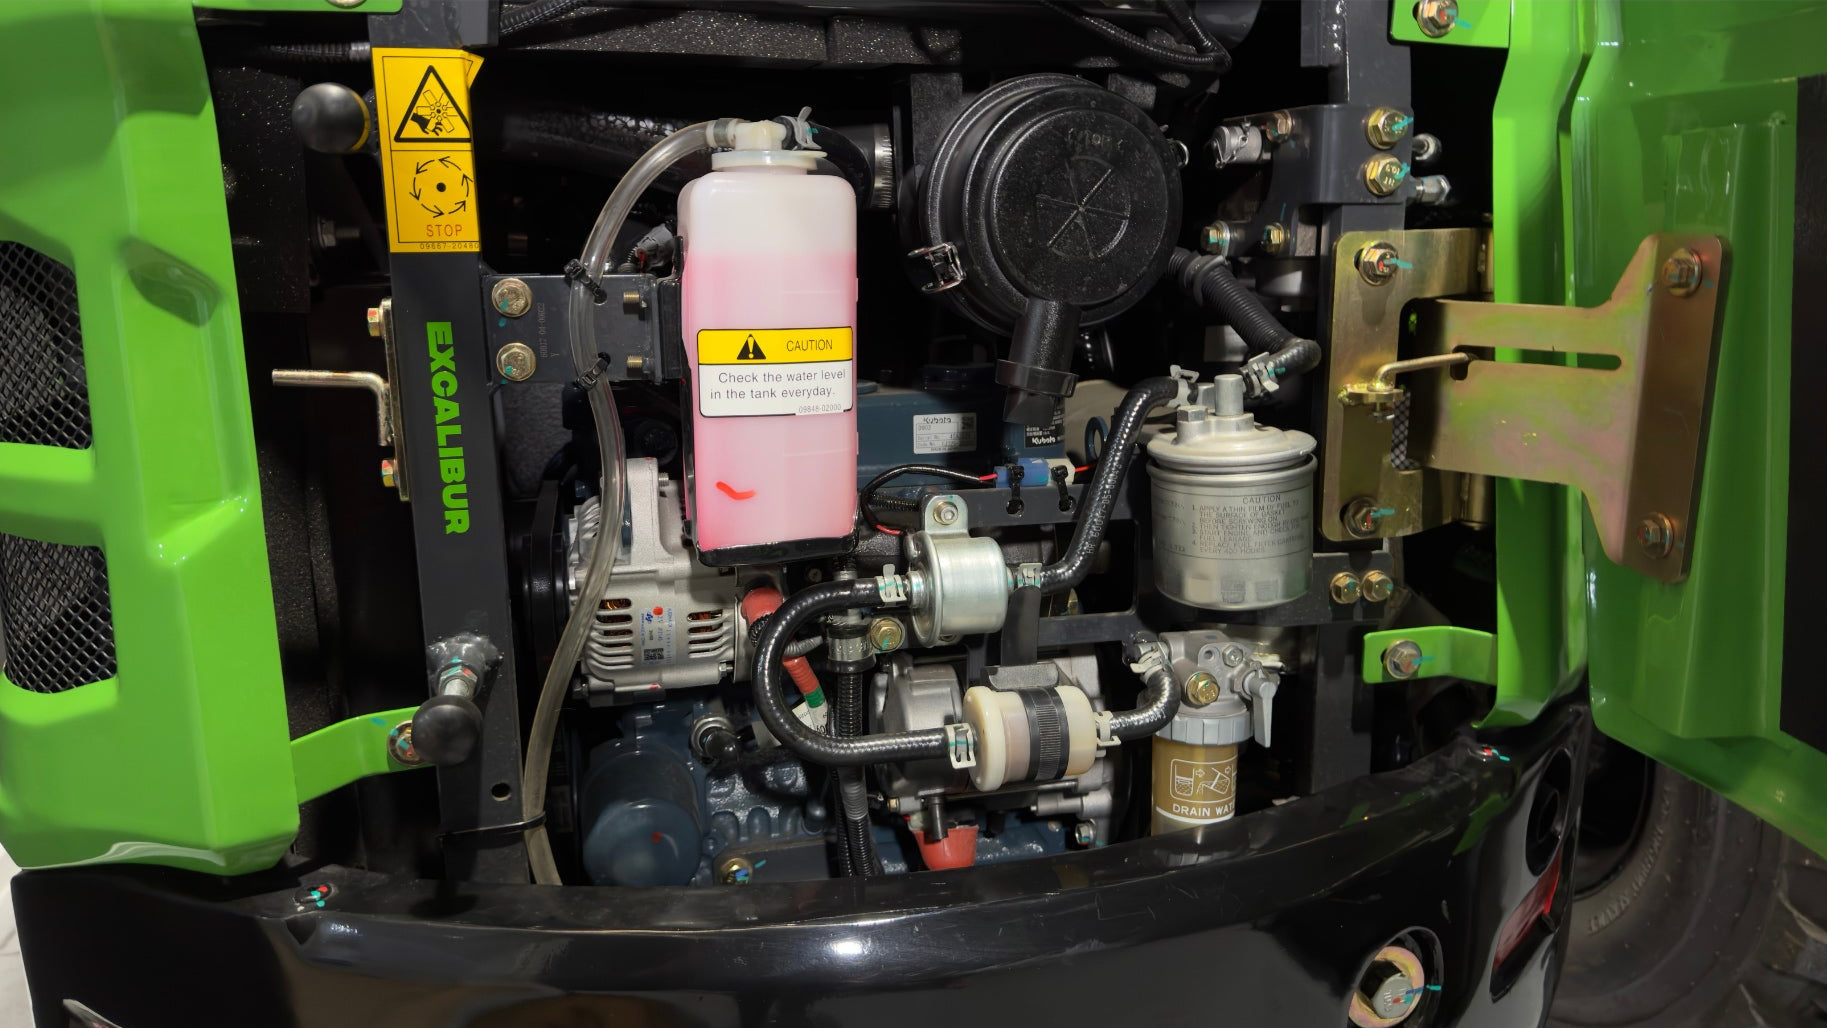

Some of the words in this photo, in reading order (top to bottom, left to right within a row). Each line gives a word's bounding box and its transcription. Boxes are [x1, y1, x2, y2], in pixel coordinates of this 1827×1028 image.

[426, 224, 463, 237] STOP
[786, 339, 833, 352] CAUTION
[718, 372, 759, 383] Check
[763, 372, 783, 382] the
[786, 371, 818, 382] water
[821, 369, 847, 380] level
[710, 389, 721, 399] in
[726, 389, 746, 399] the
[751, 388, 777, 399] tank
[781, 386, 836, 400] everyday.
[426, 321, 470, 535] EXCALIBUR
[1032, 436, 1056, 446] Kubota
[1242, 494, 1281, 504] CAUTION
[1172, 803, 1211, 817] DRAIN
